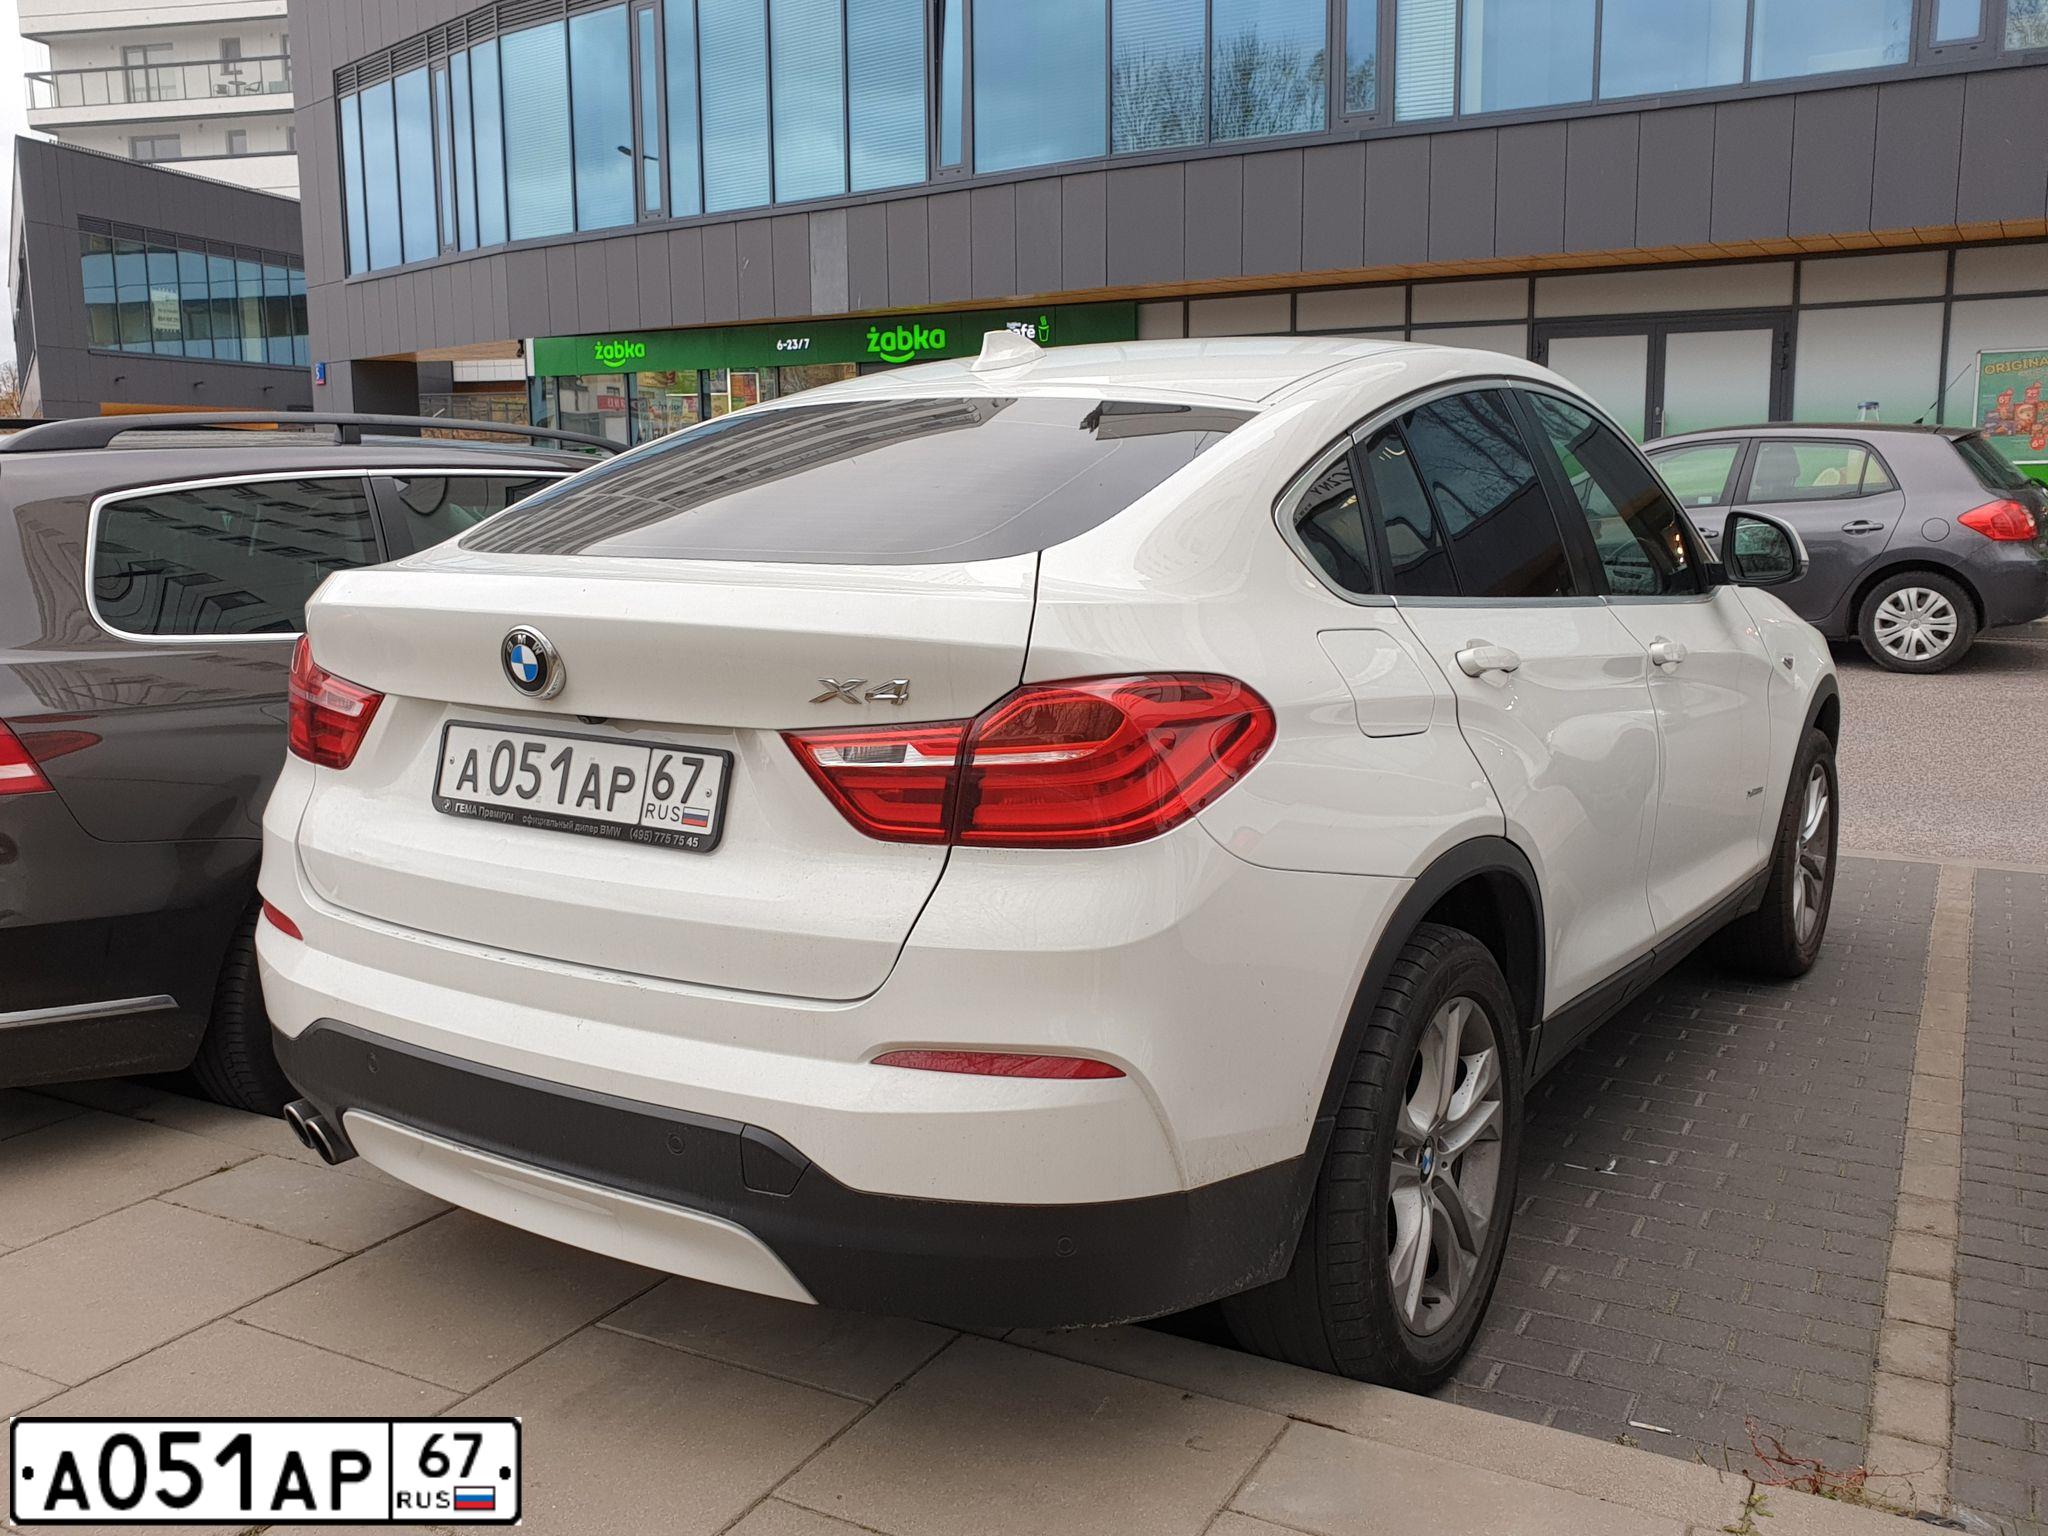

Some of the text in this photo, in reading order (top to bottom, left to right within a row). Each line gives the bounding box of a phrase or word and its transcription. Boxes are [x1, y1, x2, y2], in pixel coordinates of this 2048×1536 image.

[776, 338, 810, 351] 6-23/7
[866, 324, 946, 353] żabka
[594, 340, 646, 360] żabka
[507, 634, 543, 656] BMW
[808, 678, 910, 705] X4
[652, 754, 704, 804] 67
[644, 803, 681, 822] RUS
[600, 825, 622, 837] BMW
[629, 828, 653, 843] (495)
[654, 831, 671, 844] 775
[672, 834, 685, 846] 75
[686, 837, 699, 848] 45
